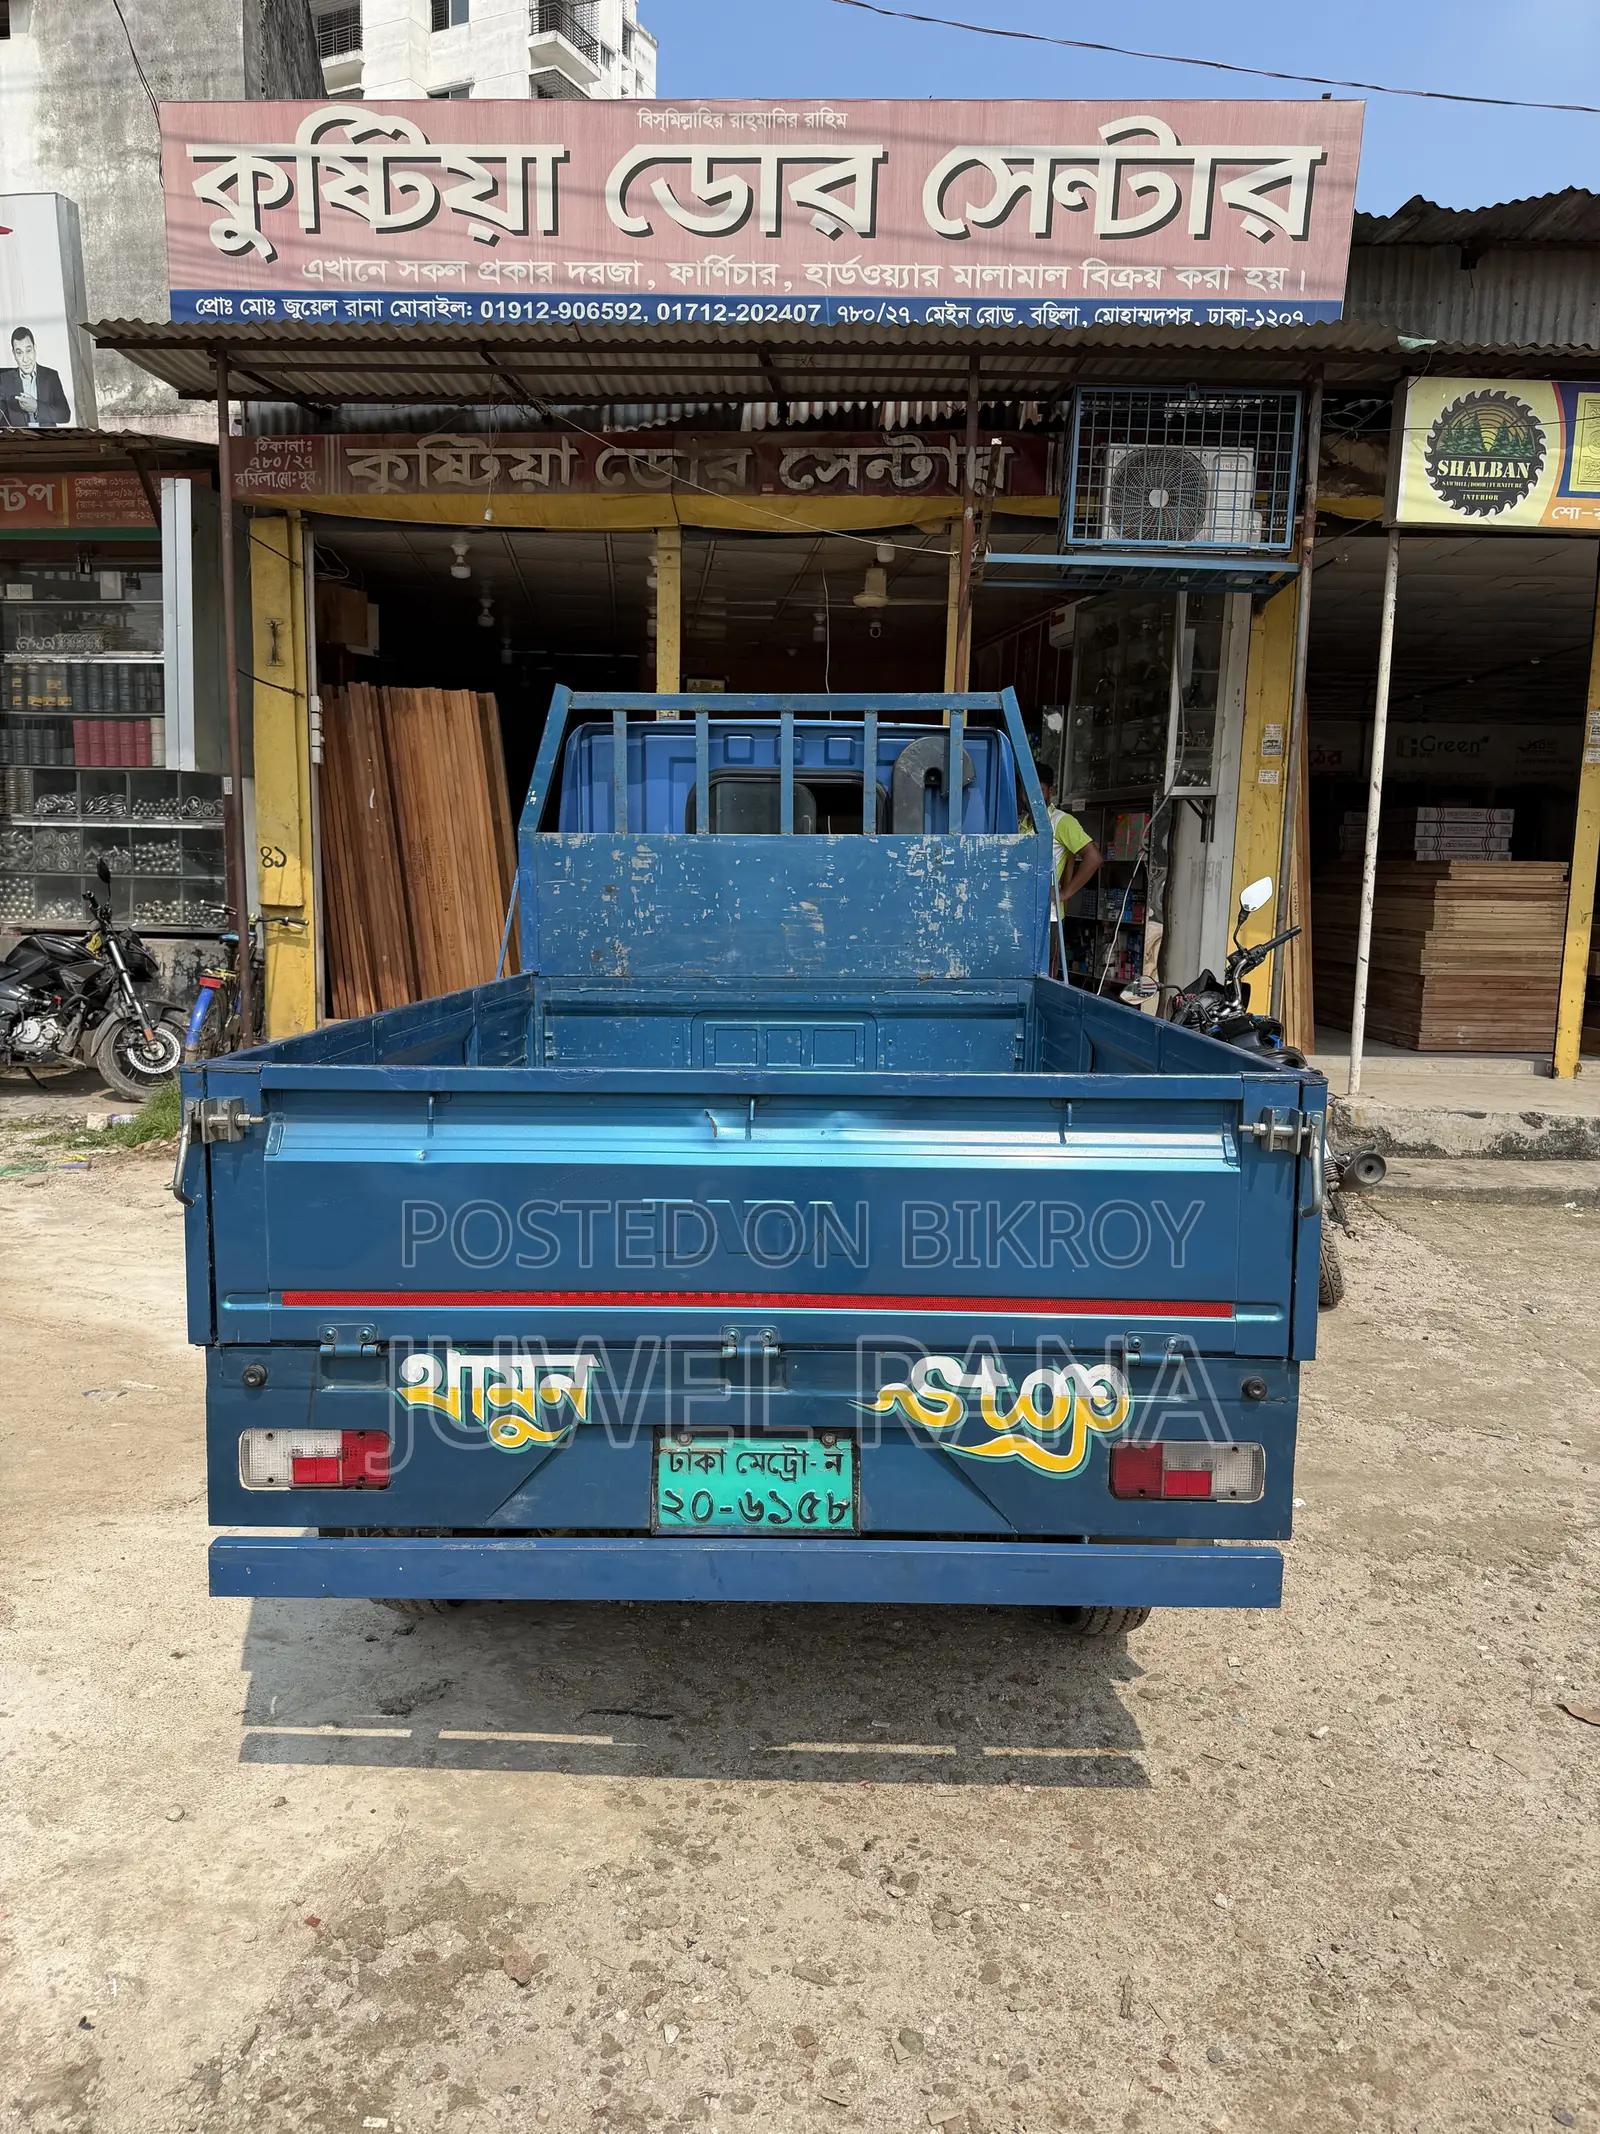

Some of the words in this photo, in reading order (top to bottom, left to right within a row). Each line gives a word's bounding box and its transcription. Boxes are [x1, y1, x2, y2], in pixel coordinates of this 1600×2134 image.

[803, 106, 848, 129] রাহিম
[186, 105, 569, 262] কুষ্টিয়া
[604, 143, 887, 241] ডোর
[922, 115, 1326, 243] সেন্টার
[301, 257, 389, 284] এখানে
[397, 260, 469, 284] সকল
[477, 260, 556, 286] প্রকার
[954, 264, 1072, 290] মালামাল
[1080, 257, 1163, 290] বিক্রয়
[1176, 264, 1237, 291] করা
[240, 298, 277, 316] মোঃ
[282, 298, 339, 320] জুয়েল
[343, 298, 385, 318] রানা
[656, 302, 822, 323] 01712-202407
[925, 300, 972, 325] মেইন
[249, 454, 313, 471] ৭৮০/২৭
[347, 433, 579, 494] কুষ্টিয়া
[595, 447, 754, 491] ডোর
[779, 432, 1015, 496] সেন্টার
[1436, 460, 1531, 479] SHALBAN
[394, 1348, 603, 1450] থামুন
[668, 1448, 728, 1475] ঢাকা
[661, 1487, 851, 1526] ২০-৬১৫৮
